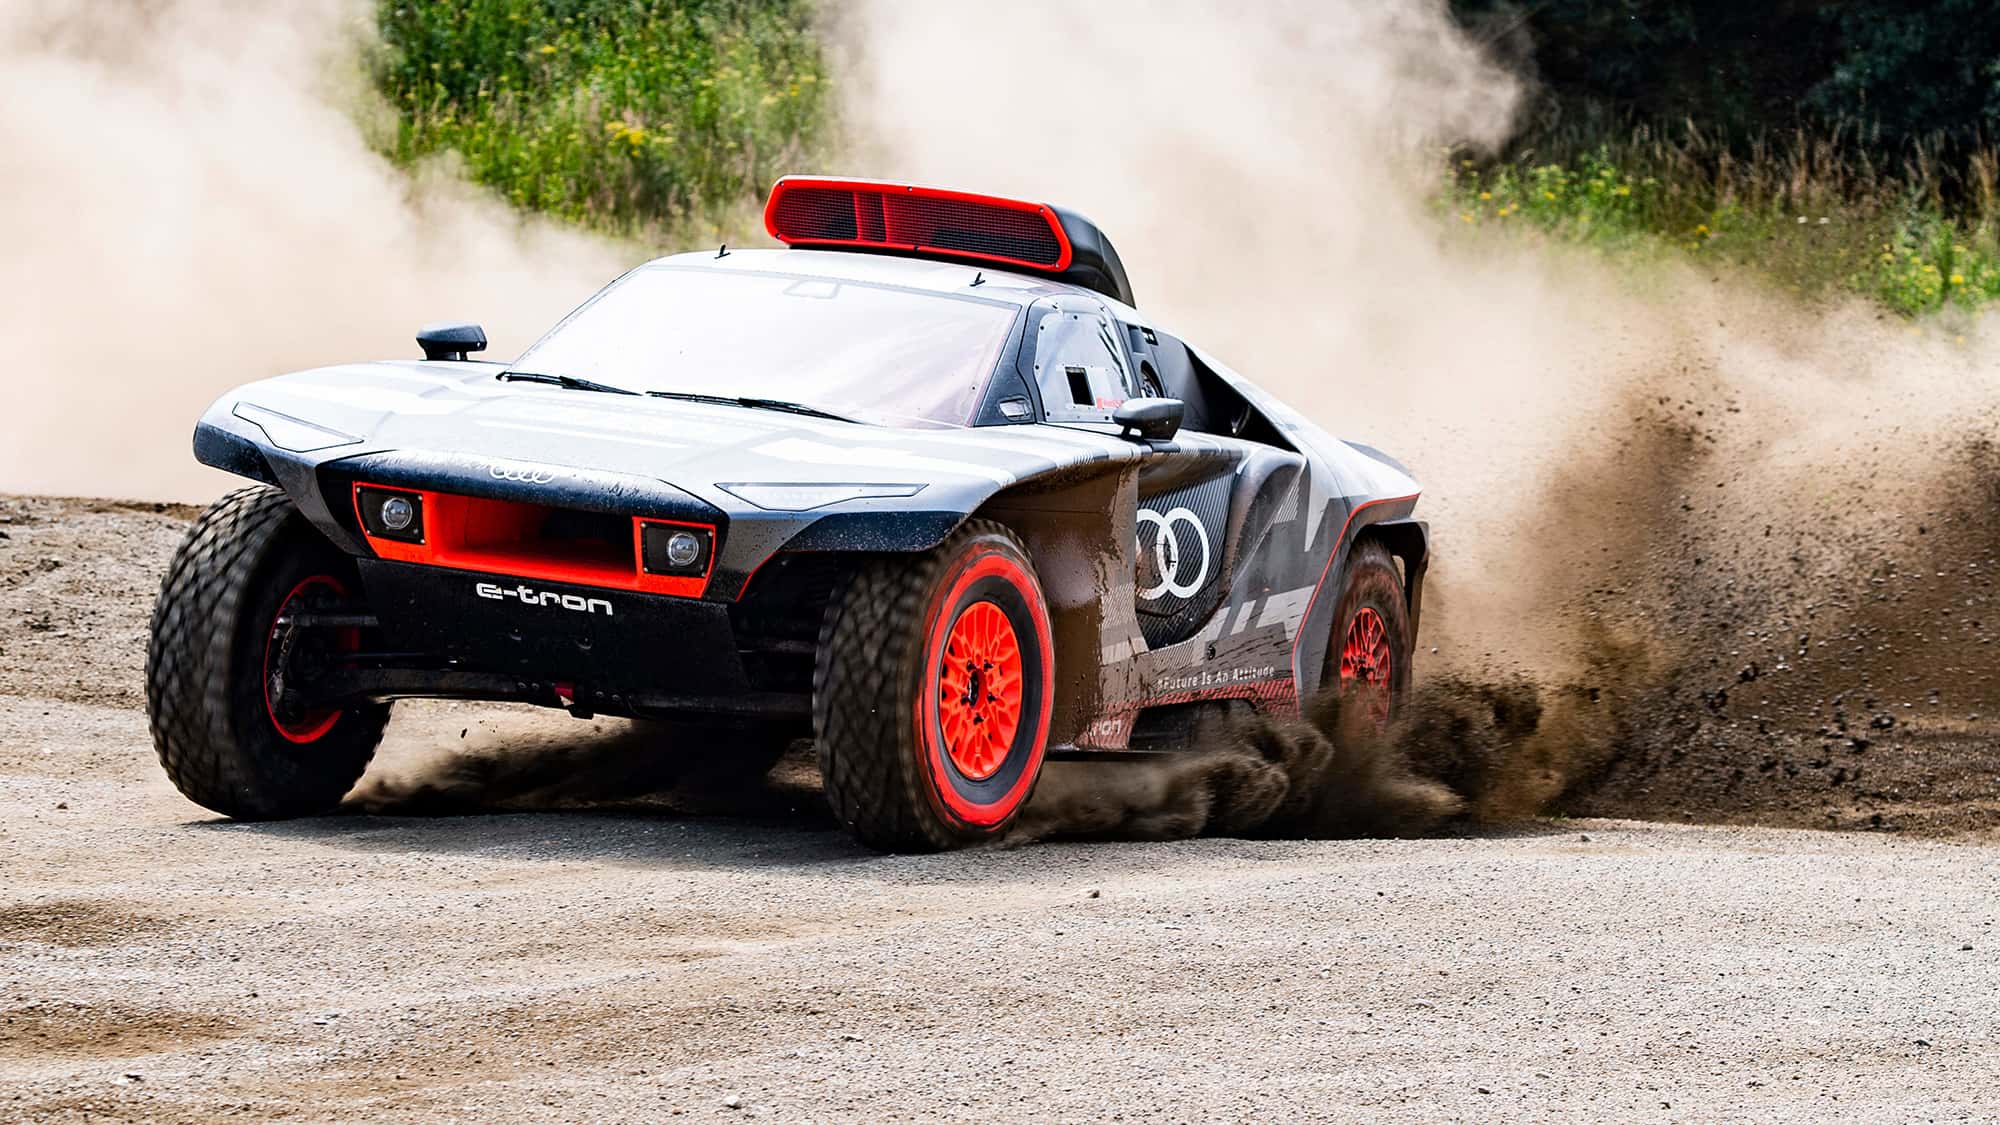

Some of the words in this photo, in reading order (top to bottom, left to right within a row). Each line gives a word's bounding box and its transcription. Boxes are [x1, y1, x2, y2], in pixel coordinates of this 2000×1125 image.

[476, 582, 613, 616] e-tron
[1201, 671, 1212, 685] Is
[1215, 671, 1229, 683] An
[1232, 665, 1275, 681] Attitude
